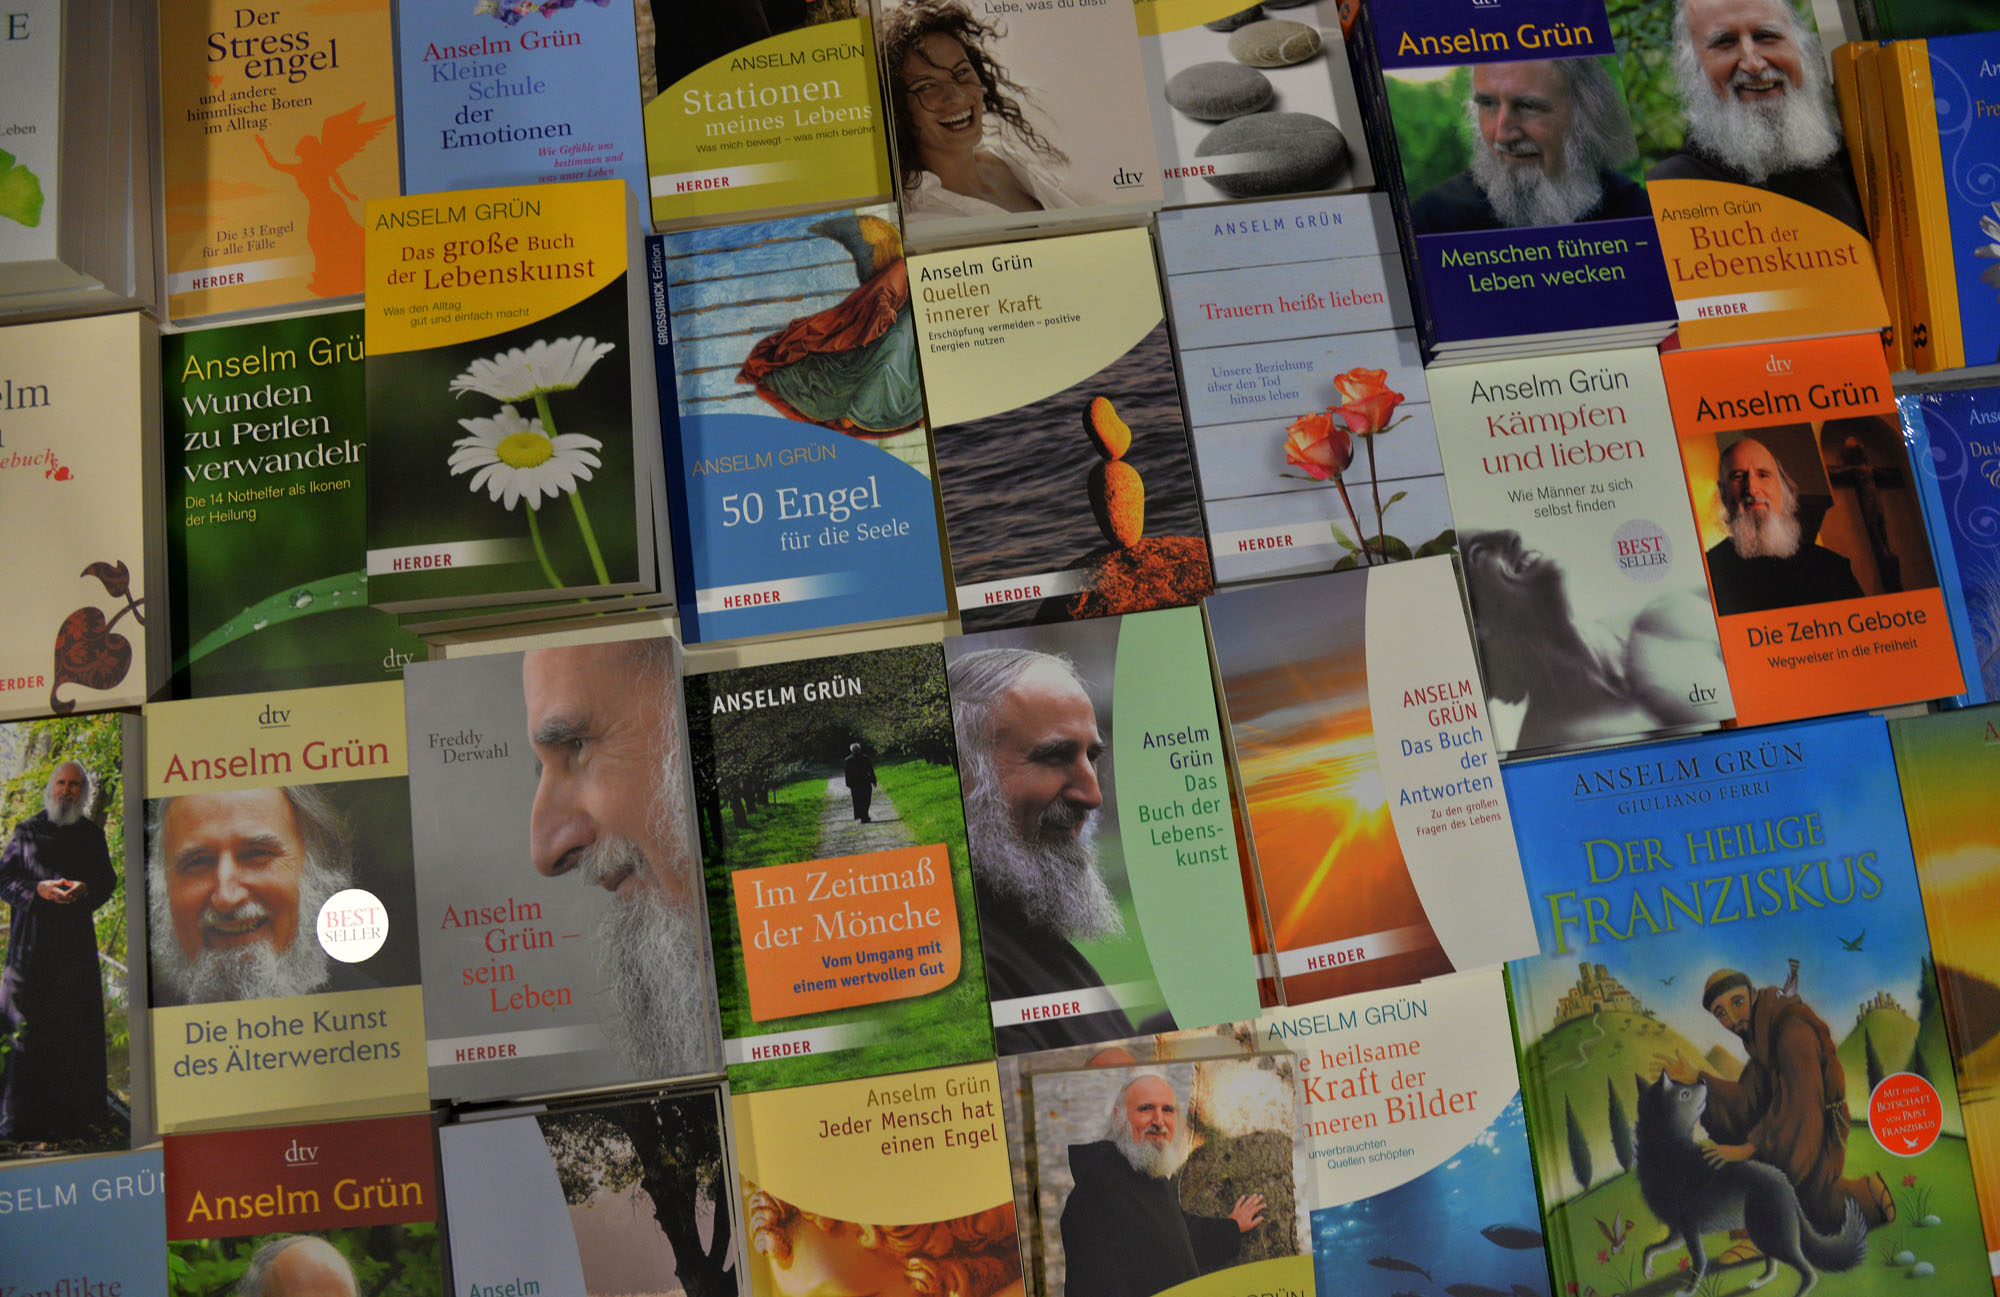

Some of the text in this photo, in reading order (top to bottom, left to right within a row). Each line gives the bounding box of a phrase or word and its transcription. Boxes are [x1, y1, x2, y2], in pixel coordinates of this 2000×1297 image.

[235, 9, 280, 28] Der
[207, 30, 310, 63] Stress
[245, 38, 339, 84] engel
[730, 44, 865, 72] ANSELM GRÜN
[432, 61, 507, 83] Kleine
[199, 86, 277, 105] und andere
[469, 75, 546, 101] Schule
[683, 79, 842, 115] Stationen
[187, 96, 313, 122] himmlische Boten
[455, 105, 494, 125] der
[705, 103, 873, 137] meines Lebens
[204, 122, 222, 135] im
[441, 122, 573, 150] Emotionen
[1214, 212, 1343, 236] ANSELM GRÜN
[1689, 219, 1799, 251] Buch der
[401, 232, 575, 264] Das große Buch
[1441, 237, 1629, 268] Menschen führen
[1672, 242, 1859, 283] Lebenskunst
[387, 257, 596, 290] der Lebenskunst
[1469, 264, 1626, 293] Leben wecken
[652, 243, 668, 346] GROSSDRUCK Edition
[922, 280, 991, 304] Quellen
[1200, 288, 1384, 321] Trauern heißt lieben
[383, 300, 462, 317] Was den Alltag
[410, 307, 530, 328] gut und einfach macht
[925, 294, 1043, 324] innerer Kraft
[928, 313, 1081, 341] Erschöpfung vermeiden positive
[930, 336, 1005, 353] Energien nutzen
[1766, 354, 1793, 373] dtv
[182, 384, 312, 418] Wunden
[1696, 382, 1879, 423] Anselm Grün
[184, 414, 331, 451] zu Perlen
[1487, 404, 1627, 438] Kämpfen
[1482, 438, 1645, 475] und lieben
[185, 479, 351, 509] Die 14 Nothelfer als Ikonen
[721, 475, 882, 527] 50 Engel
[1508, 478, 1634, 503] Wie Männer zu sich
[186, 508, 257, 527] der Heilung
[1533, 500, 1616, 519] selbst finden
[780, 518, 910, 552] für die Seele
[1616, 536, 1663, 556] BEST
[1619, 552, 1668, 569] SELLER
[1747, 609, 1927, 648] Die Zehn Gebote
[1767, 638, 1919, 670] Wegweiser in die Freiheit
[428, 729, 484, 749] Freddy
[442, 743, 509, 764] Derwahl
[1400, 726, 1484, 757] Das Buch
[163, 739, 389, 784] Anselm Grün
[1460, 752, 1488, 770] der
[1573, 741, 1804, 797] ANSELM GRÜN
[1185, 774, 1217, 793] Das
[1400, 775, 1493, 807] Antworten
[1618, 780, 1771, 816] GIULIANO FERRI
[1138, 797, 1221, 823] Buch der
[1416, 812, 1501, 837] Fragen des Lebens
[1431, 799, 1498, 820] Zu den großen
[1151, 824, 1224, 846] Lebens-
[1582, 812, 1825, 885] DER HEILIGE
[1175, 844, 1229, 867] kunst
[752, 856, 935, 910] Im Zeitmaß
[440, 897, 543, 929] Anselm
[1544, 852, 1884, 957] FRANZISKUS
[485, 928, 555, 954] Grün
[754, 901, 942, 951] der Mönche
[821, 940, 942, 970] Vom Umgang mit
[1307, 948, 1366, 971] HERDER
[462, 958, 515, 986] sein
[793, 961, 945, 994] einem wertvollen Gut
[490, 984, 573, 1013] Leben
[185, 1008, 388, 1045] Die hohe Kunst
[173, 1039, 402, 1078] des Älterwerdens
[1321, 1039, 1421, 1070] heilsame
[1301, 1067, 1427, 1105] Kraft der
[819, 1100, 995, 1138] Jeder Mensch hat
[1385, 1087, 1478, 1125] Bilder
[881, 1123, 999, 1155] einen Engel
[1327, 1147, 1415, 1170] Quellen schöpfen
[186, 1177, 424, 1223] Anselm Grün
